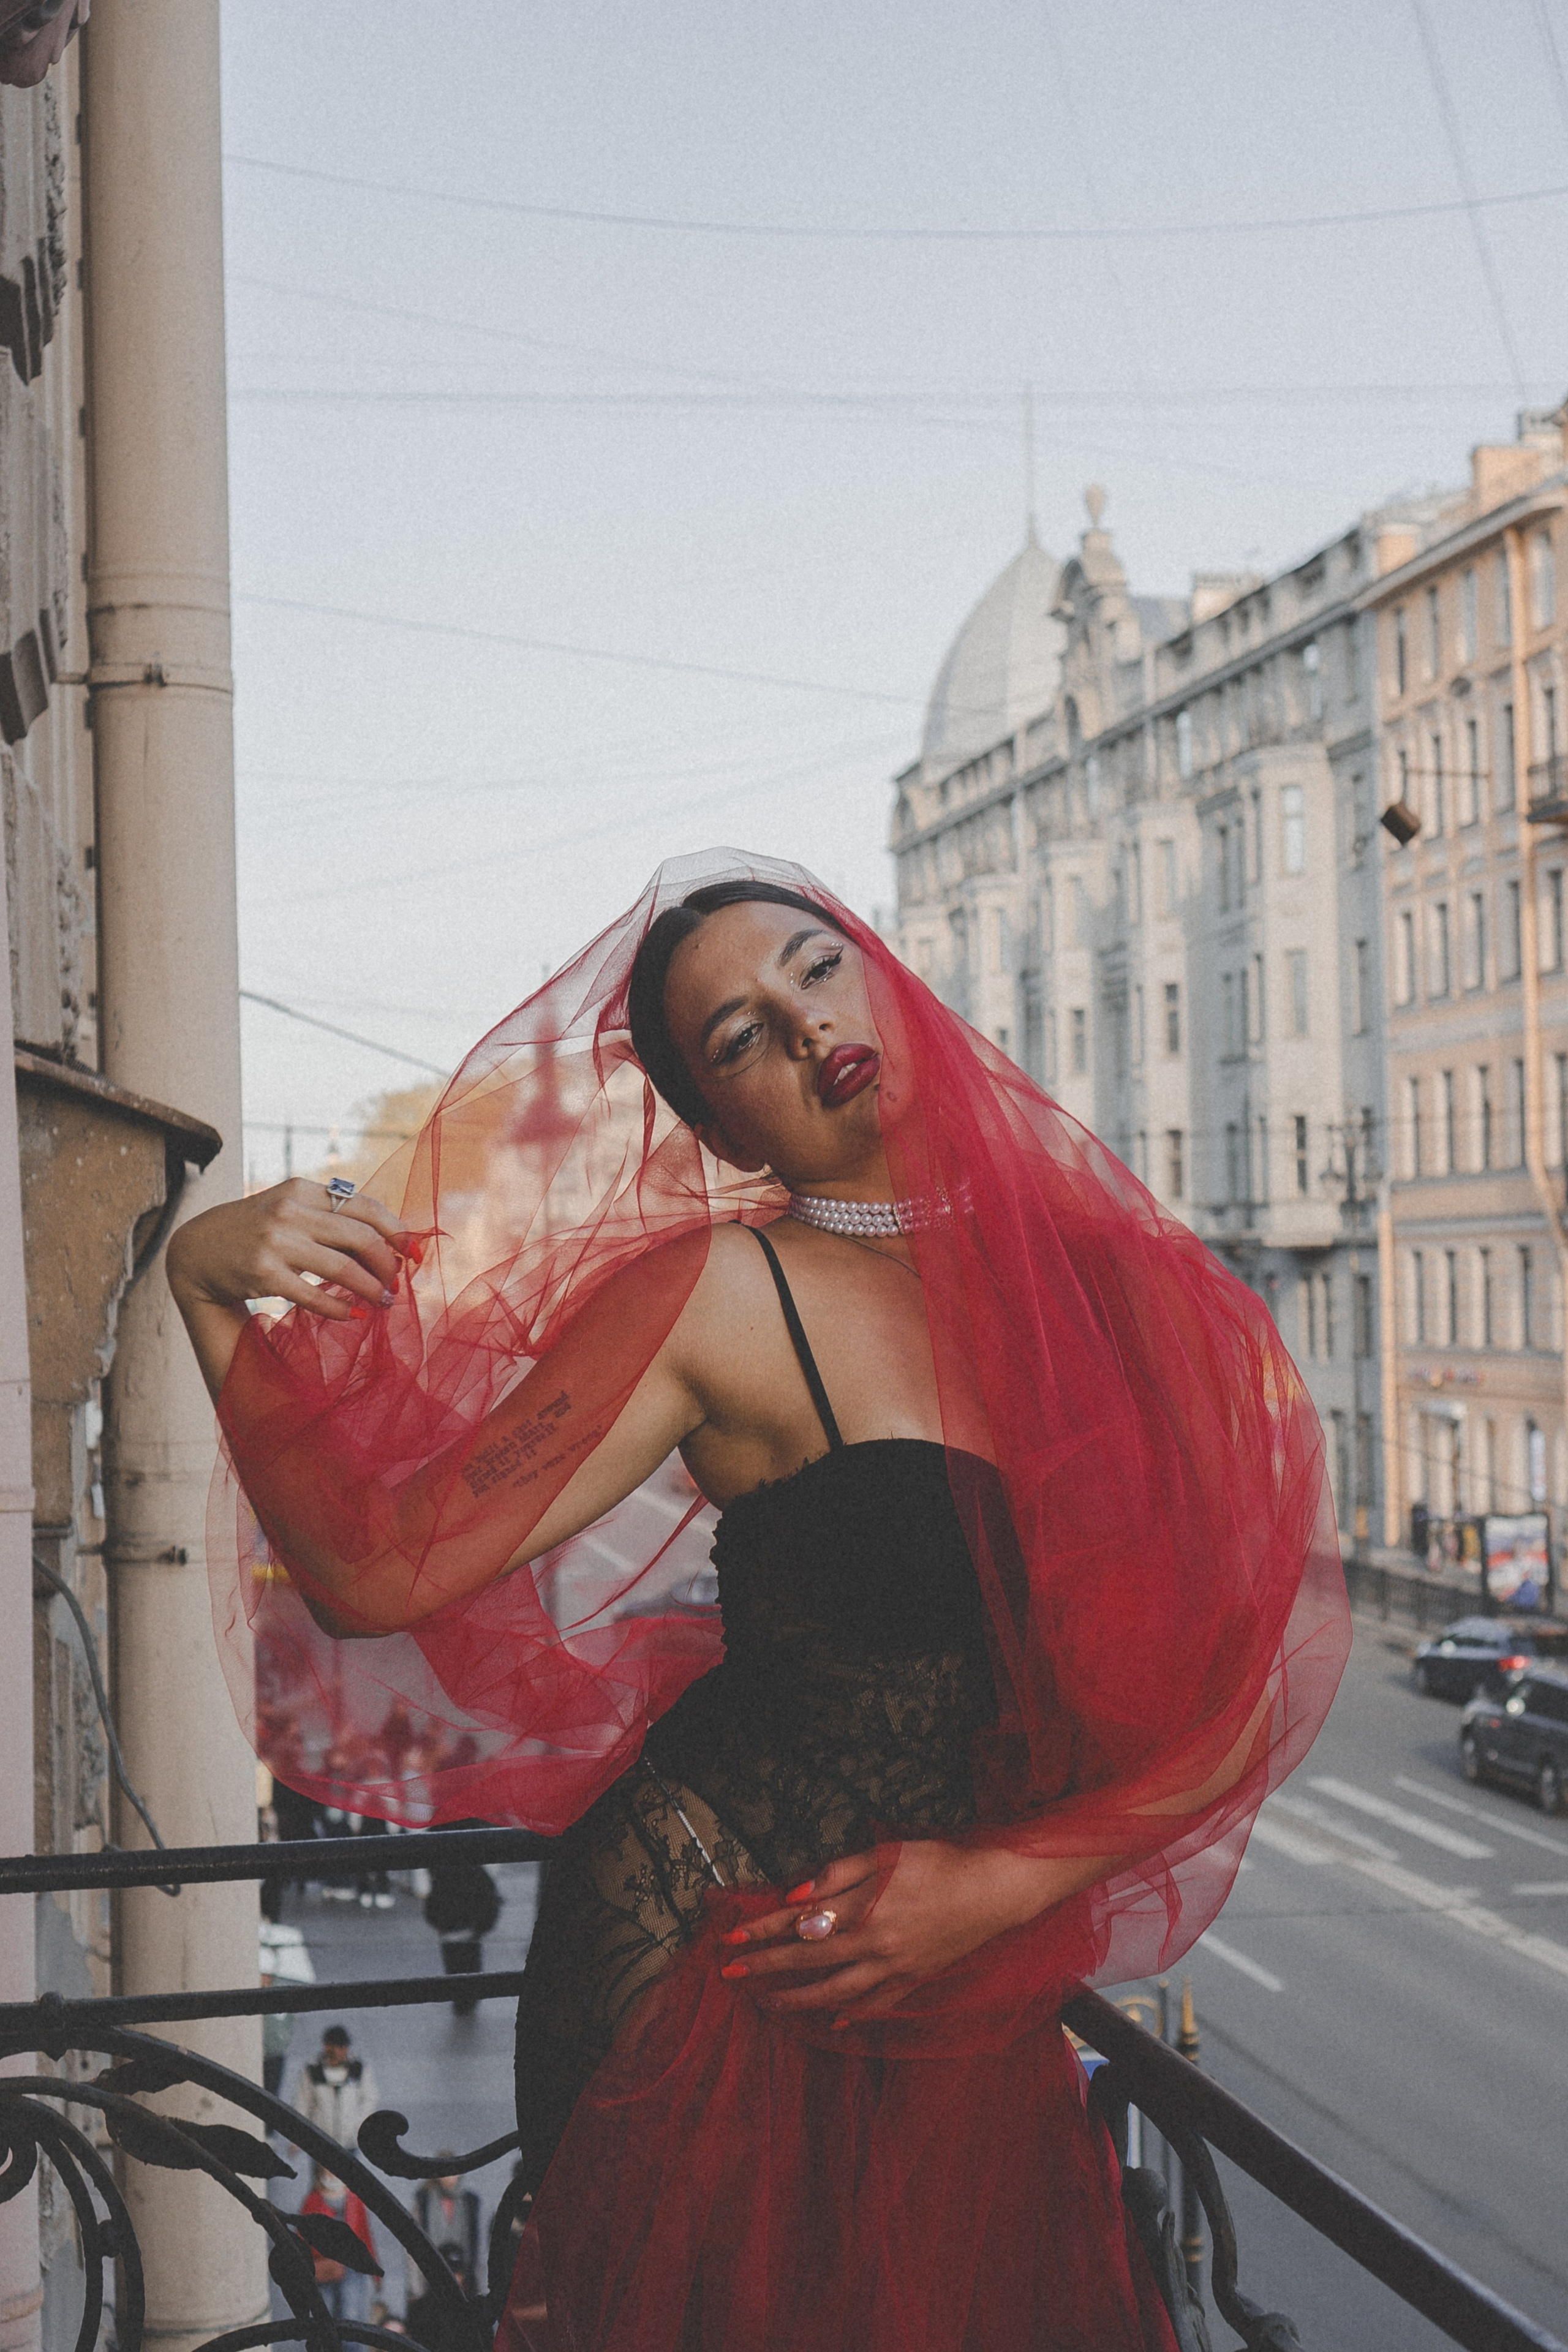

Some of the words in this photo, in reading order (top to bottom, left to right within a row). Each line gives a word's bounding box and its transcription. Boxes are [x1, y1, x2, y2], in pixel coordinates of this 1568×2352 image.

[472, 1442, 499, 1463] built
[537, 1390, 570, 1420] around
[483, 1442, 517, 1467] broken
[554, 1401, 572, 1418] and
